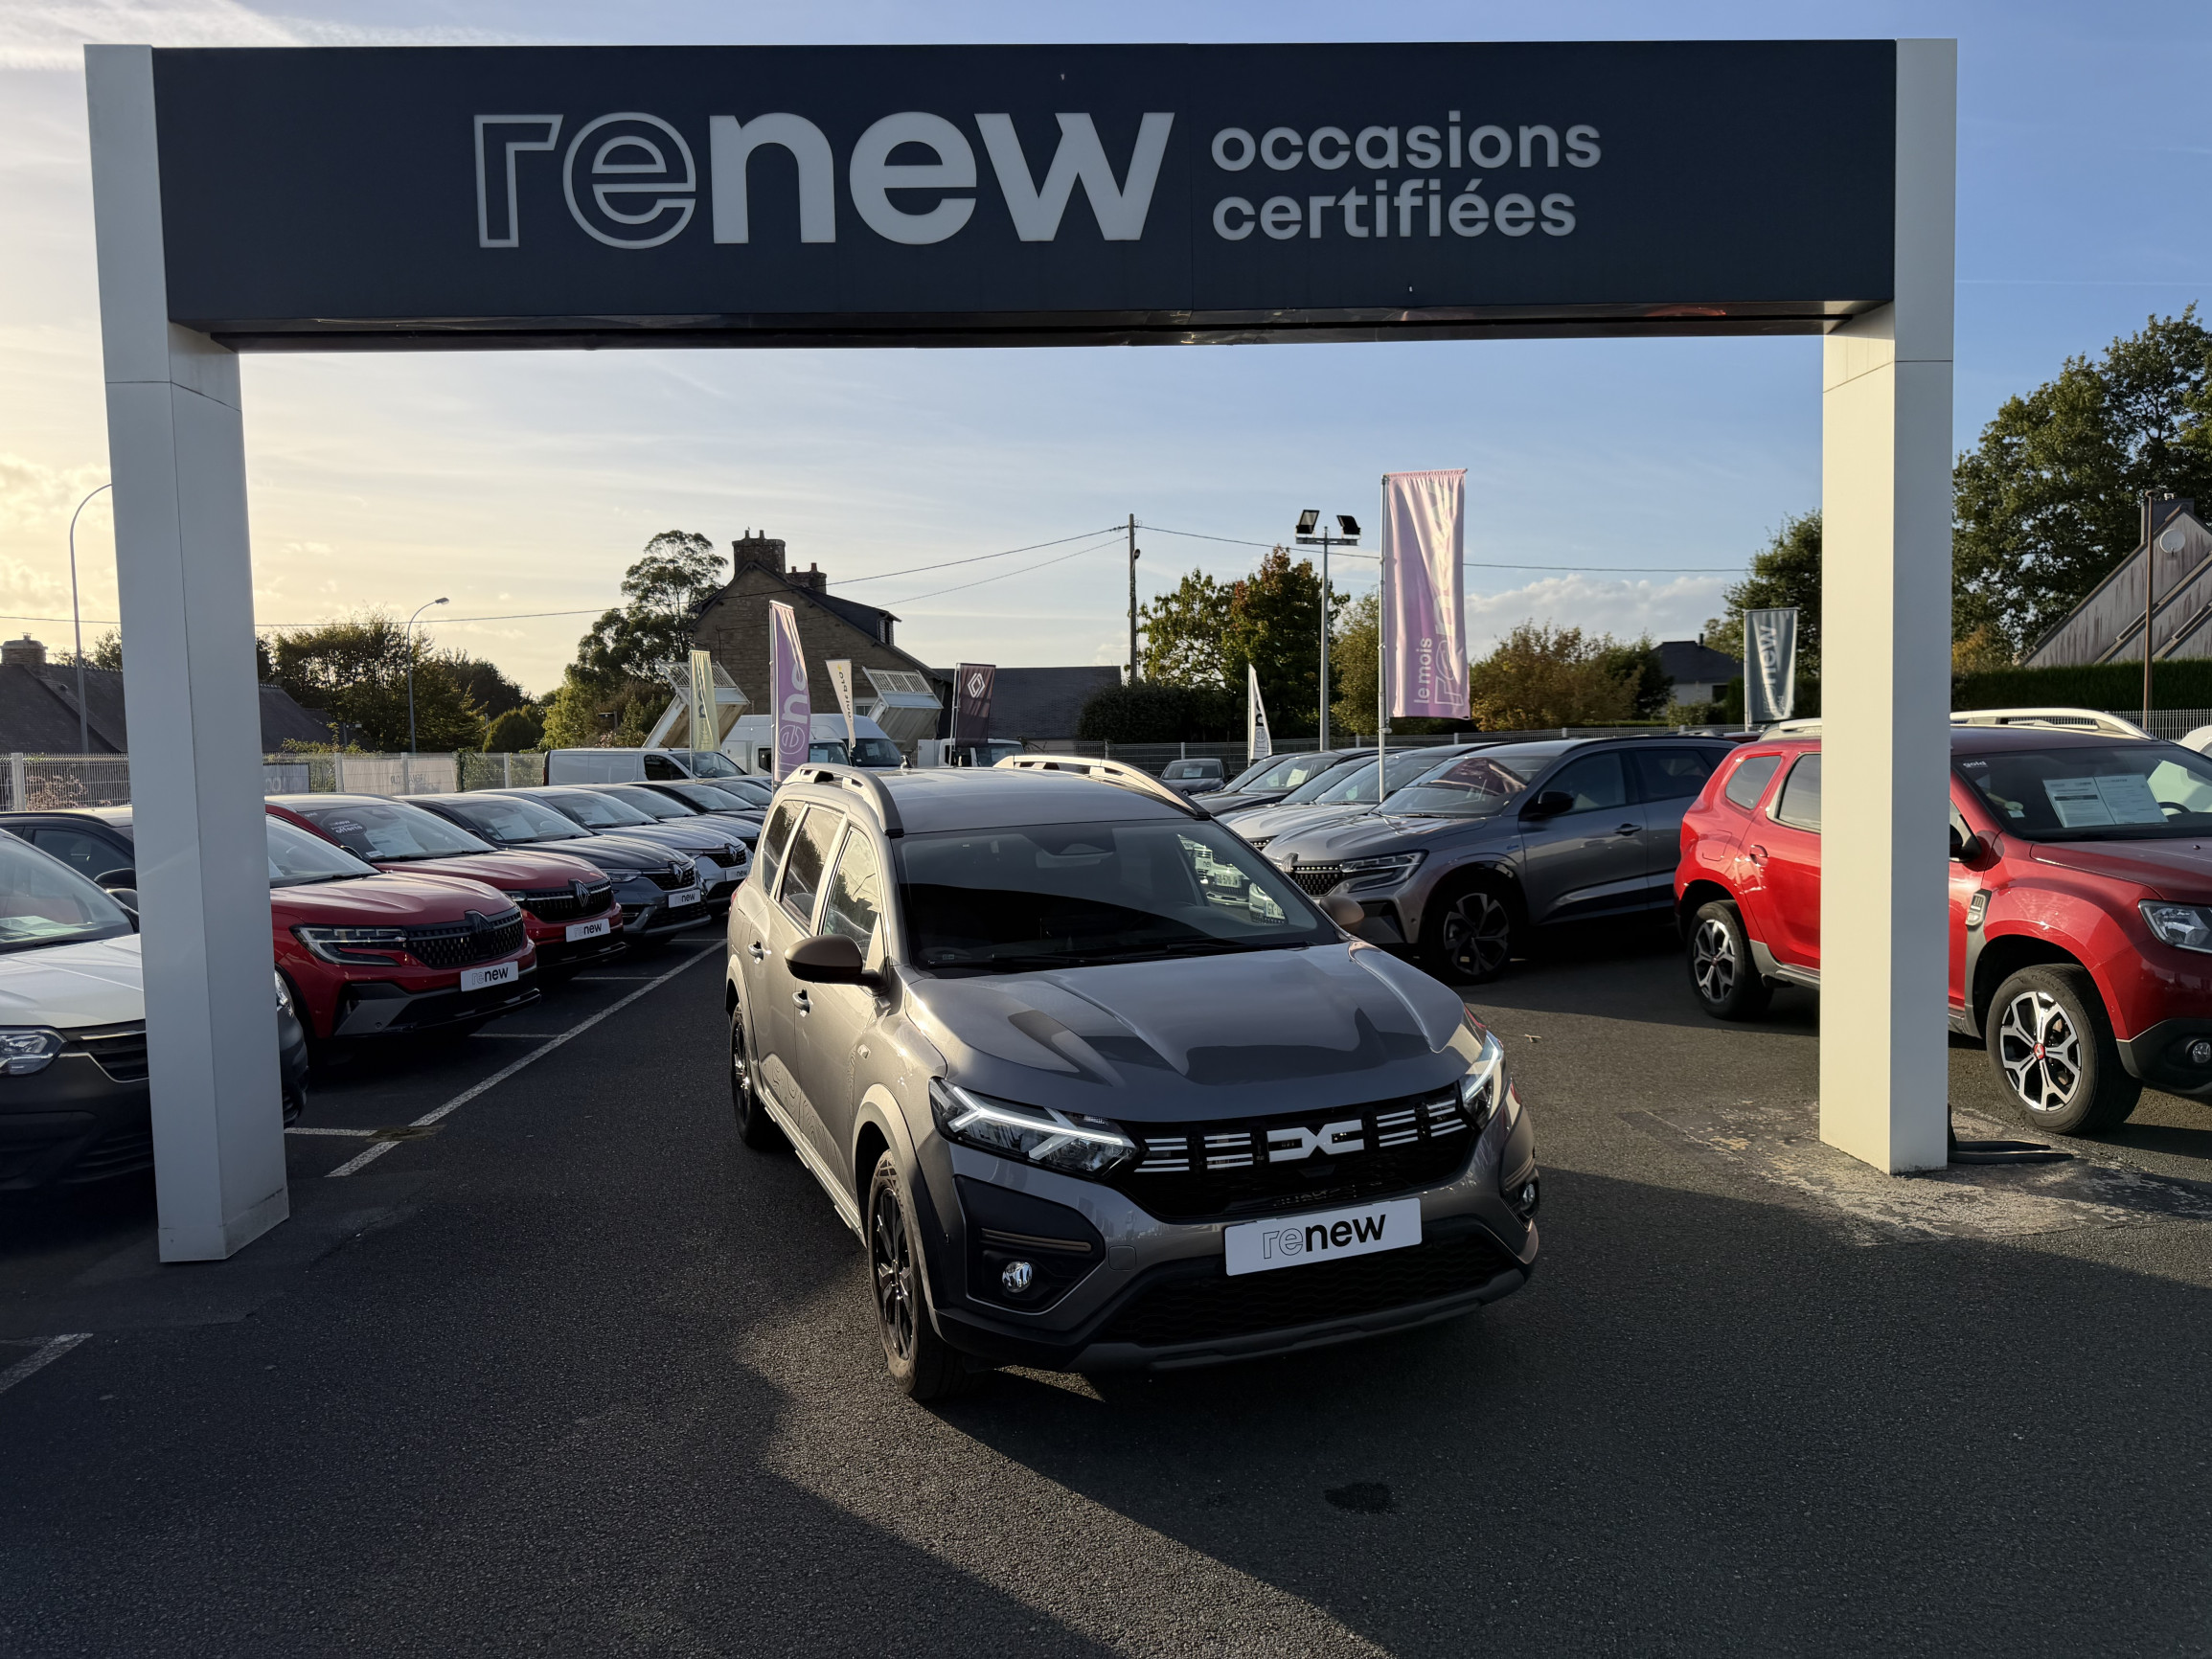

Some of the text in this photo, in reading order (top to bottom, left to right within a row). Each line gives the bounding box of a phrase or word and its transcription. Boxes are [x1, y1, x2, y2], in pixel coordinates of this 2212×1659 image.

[1211, 110, 1601, 171] occasions
[473, 111, 1175, 250] renew
[1212, 179, 1576, 241] certifiées
[1413, 637, 1432, 704] le mois
[574, 922, 603, 938] renew
[472, 966, 509, 986] renew
[1263, 1215, 1386, 1260] renew
